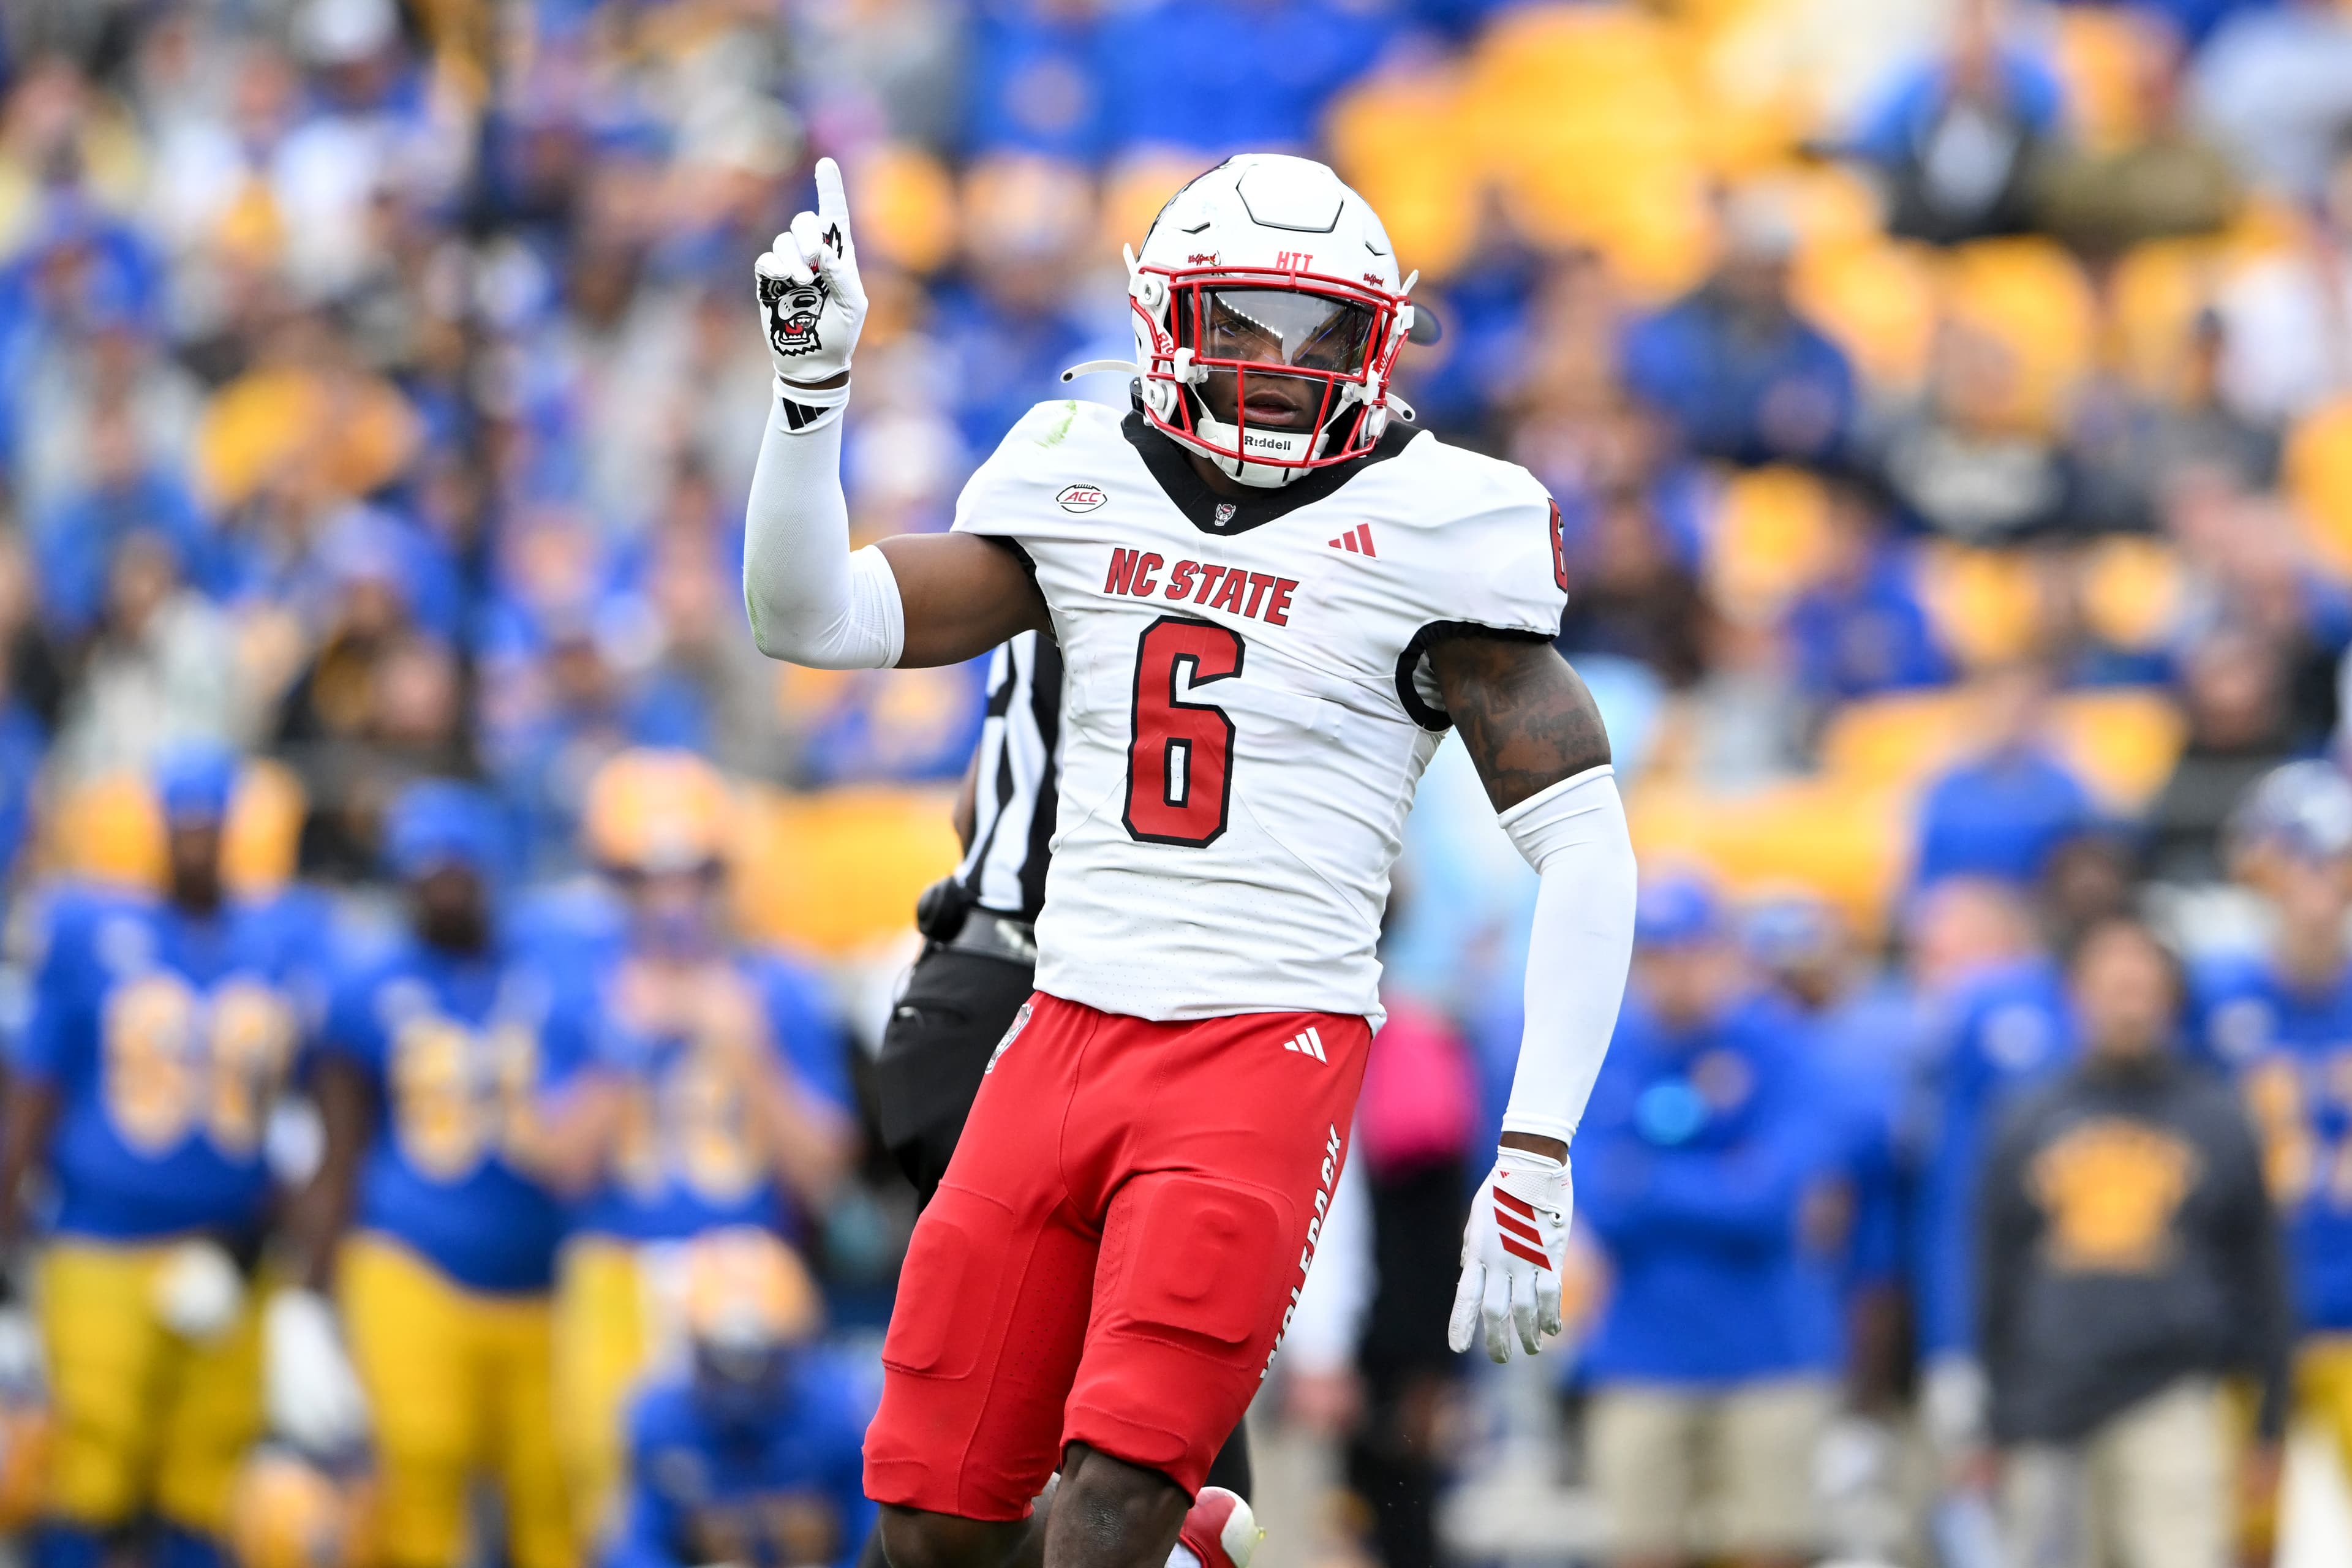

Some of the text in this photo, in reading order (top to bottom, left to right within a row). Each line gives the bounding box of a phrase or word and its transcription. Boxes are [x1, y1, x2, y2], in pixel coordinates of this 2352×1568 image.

[1276, 251, 1313, 272] HTT
[1244, 435, 1291, 450] Riddell
[1063, 491, 1101, 502] ACC
[1104, 548, 1300, 627] NC STATE
[1121, 614, 1246, 849] 6
